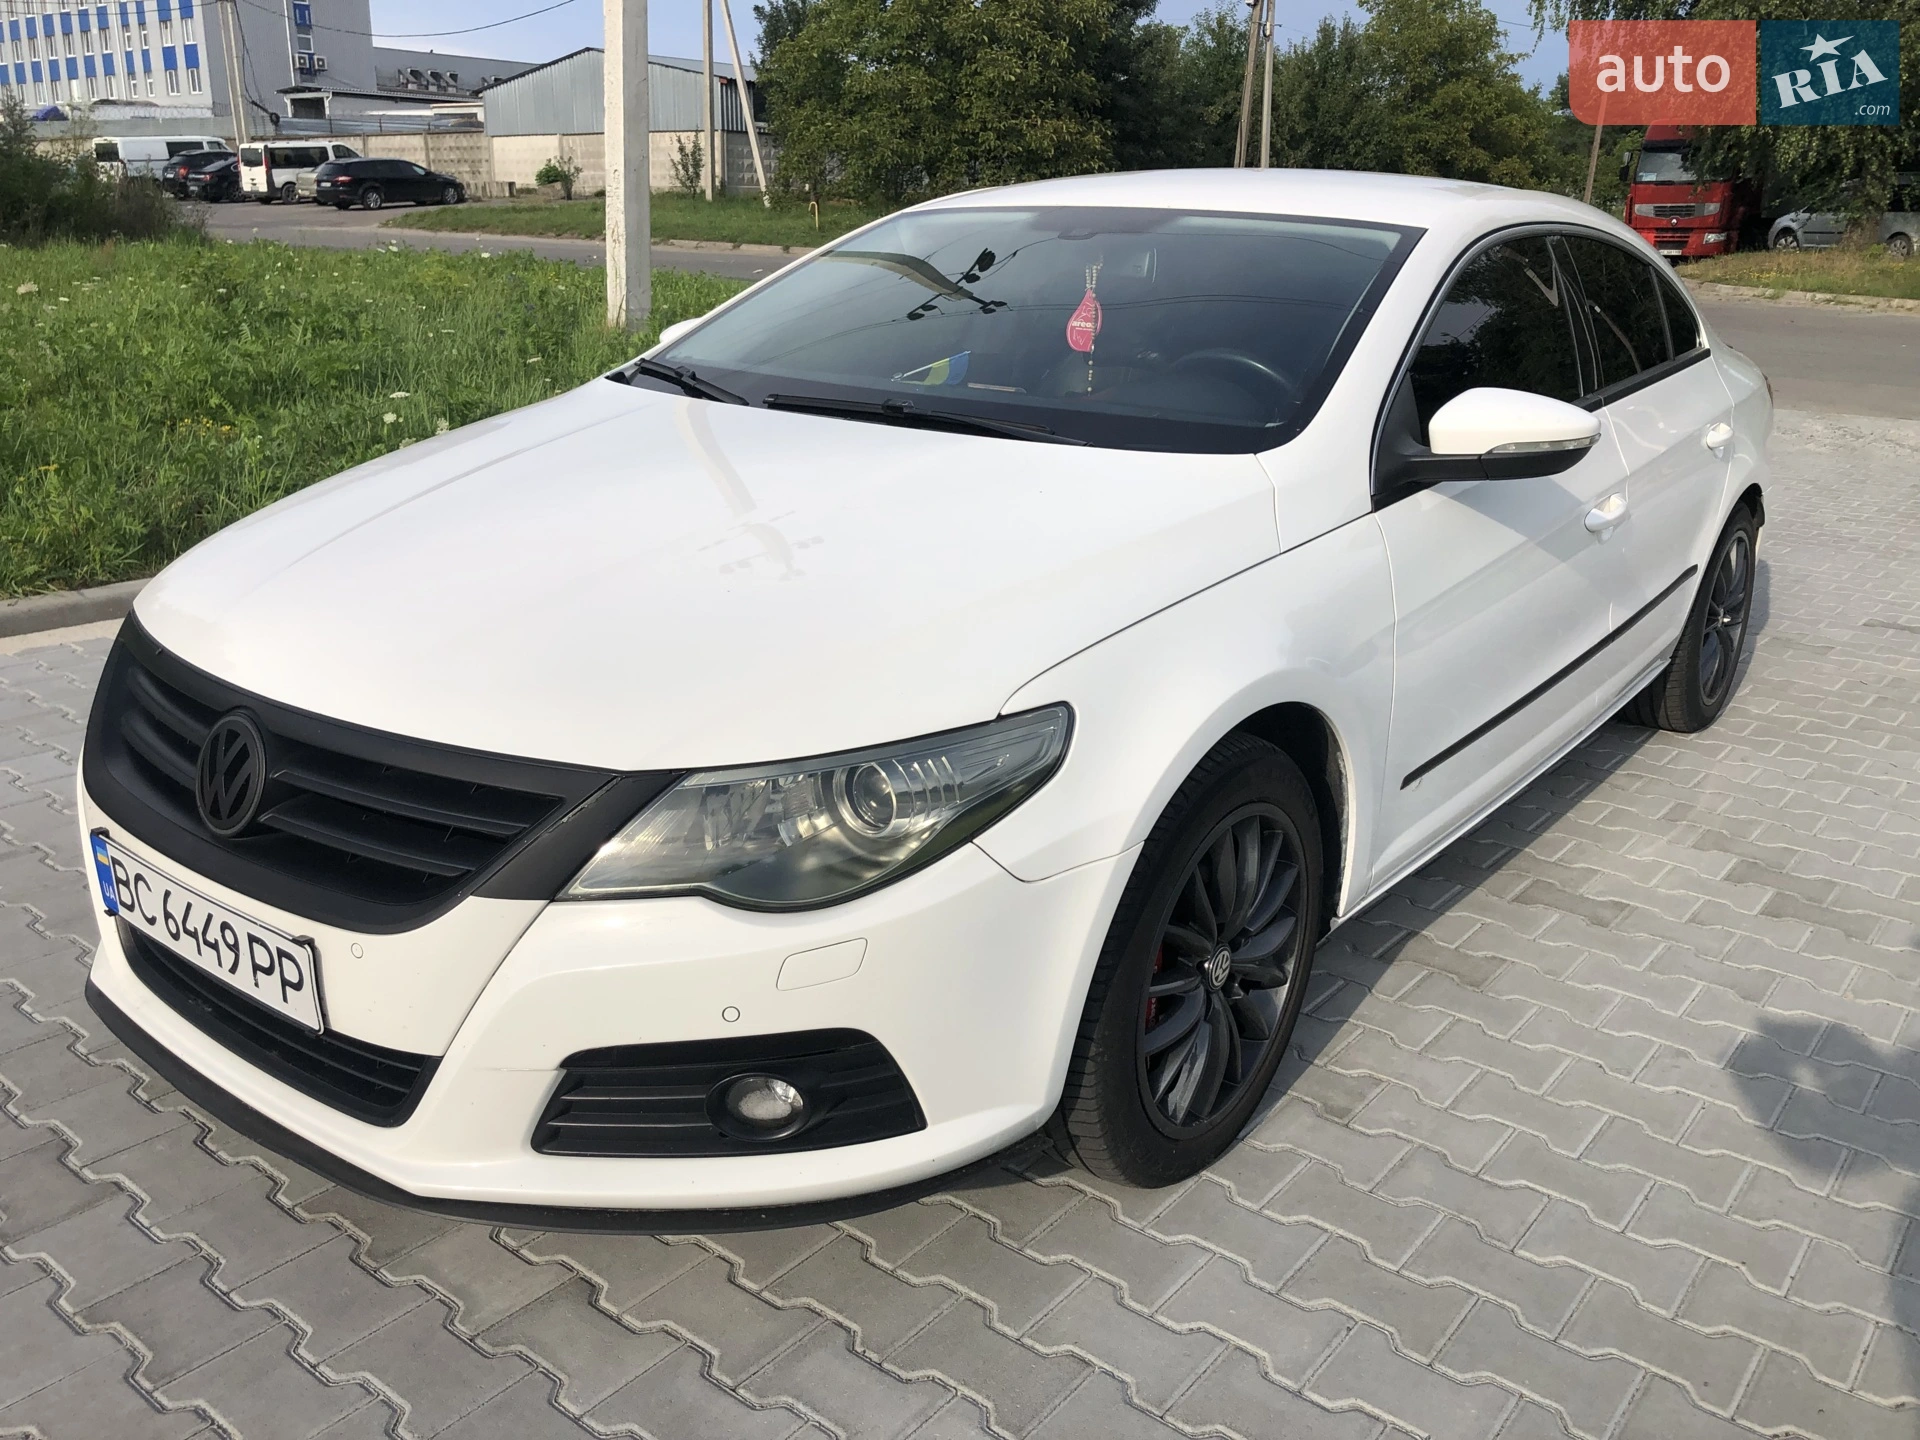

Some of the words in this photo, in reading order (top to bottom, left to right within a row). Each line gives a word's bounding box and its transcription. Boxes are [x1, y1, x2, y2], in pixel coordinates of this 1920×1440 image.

[102, 880, 117, 902] UA
[110, 854, 157, 927] BC
[162, 889, 241, 977] 6449
[247, 931, 305, 1005] PP
